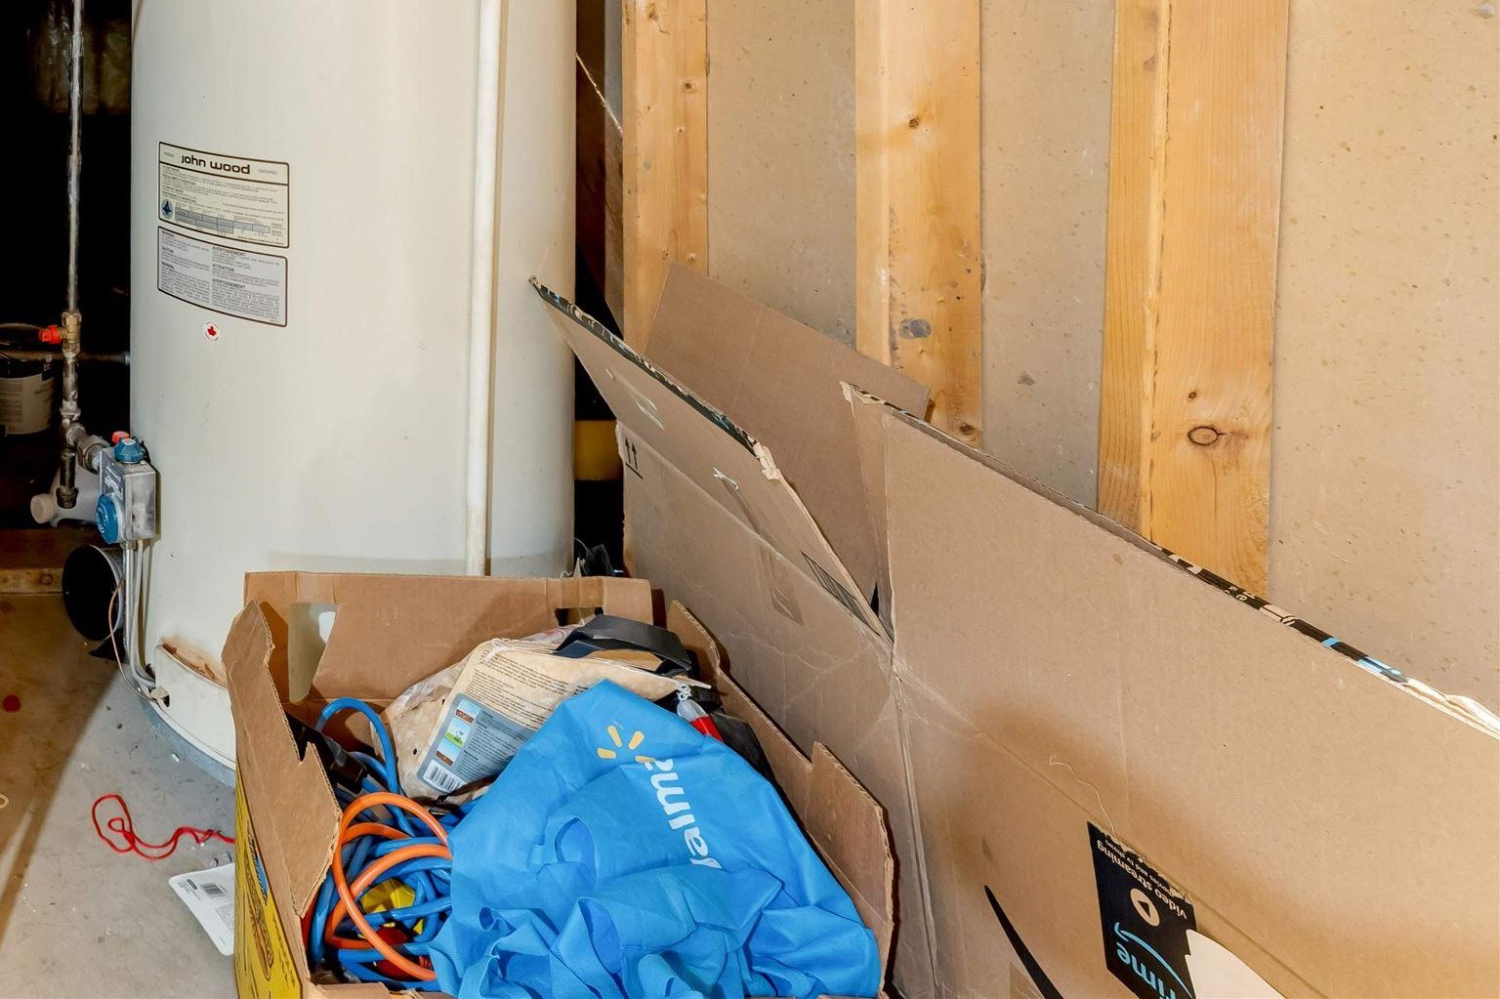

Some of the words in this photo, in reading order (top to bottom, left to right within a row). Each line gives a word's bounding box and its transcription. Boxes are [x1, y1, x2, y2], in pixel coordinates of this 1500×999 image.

[210, 160, 250, 174] wood
[1096, 840, 1153, 890] streaming
[1154, 888, 1188, 920] video
